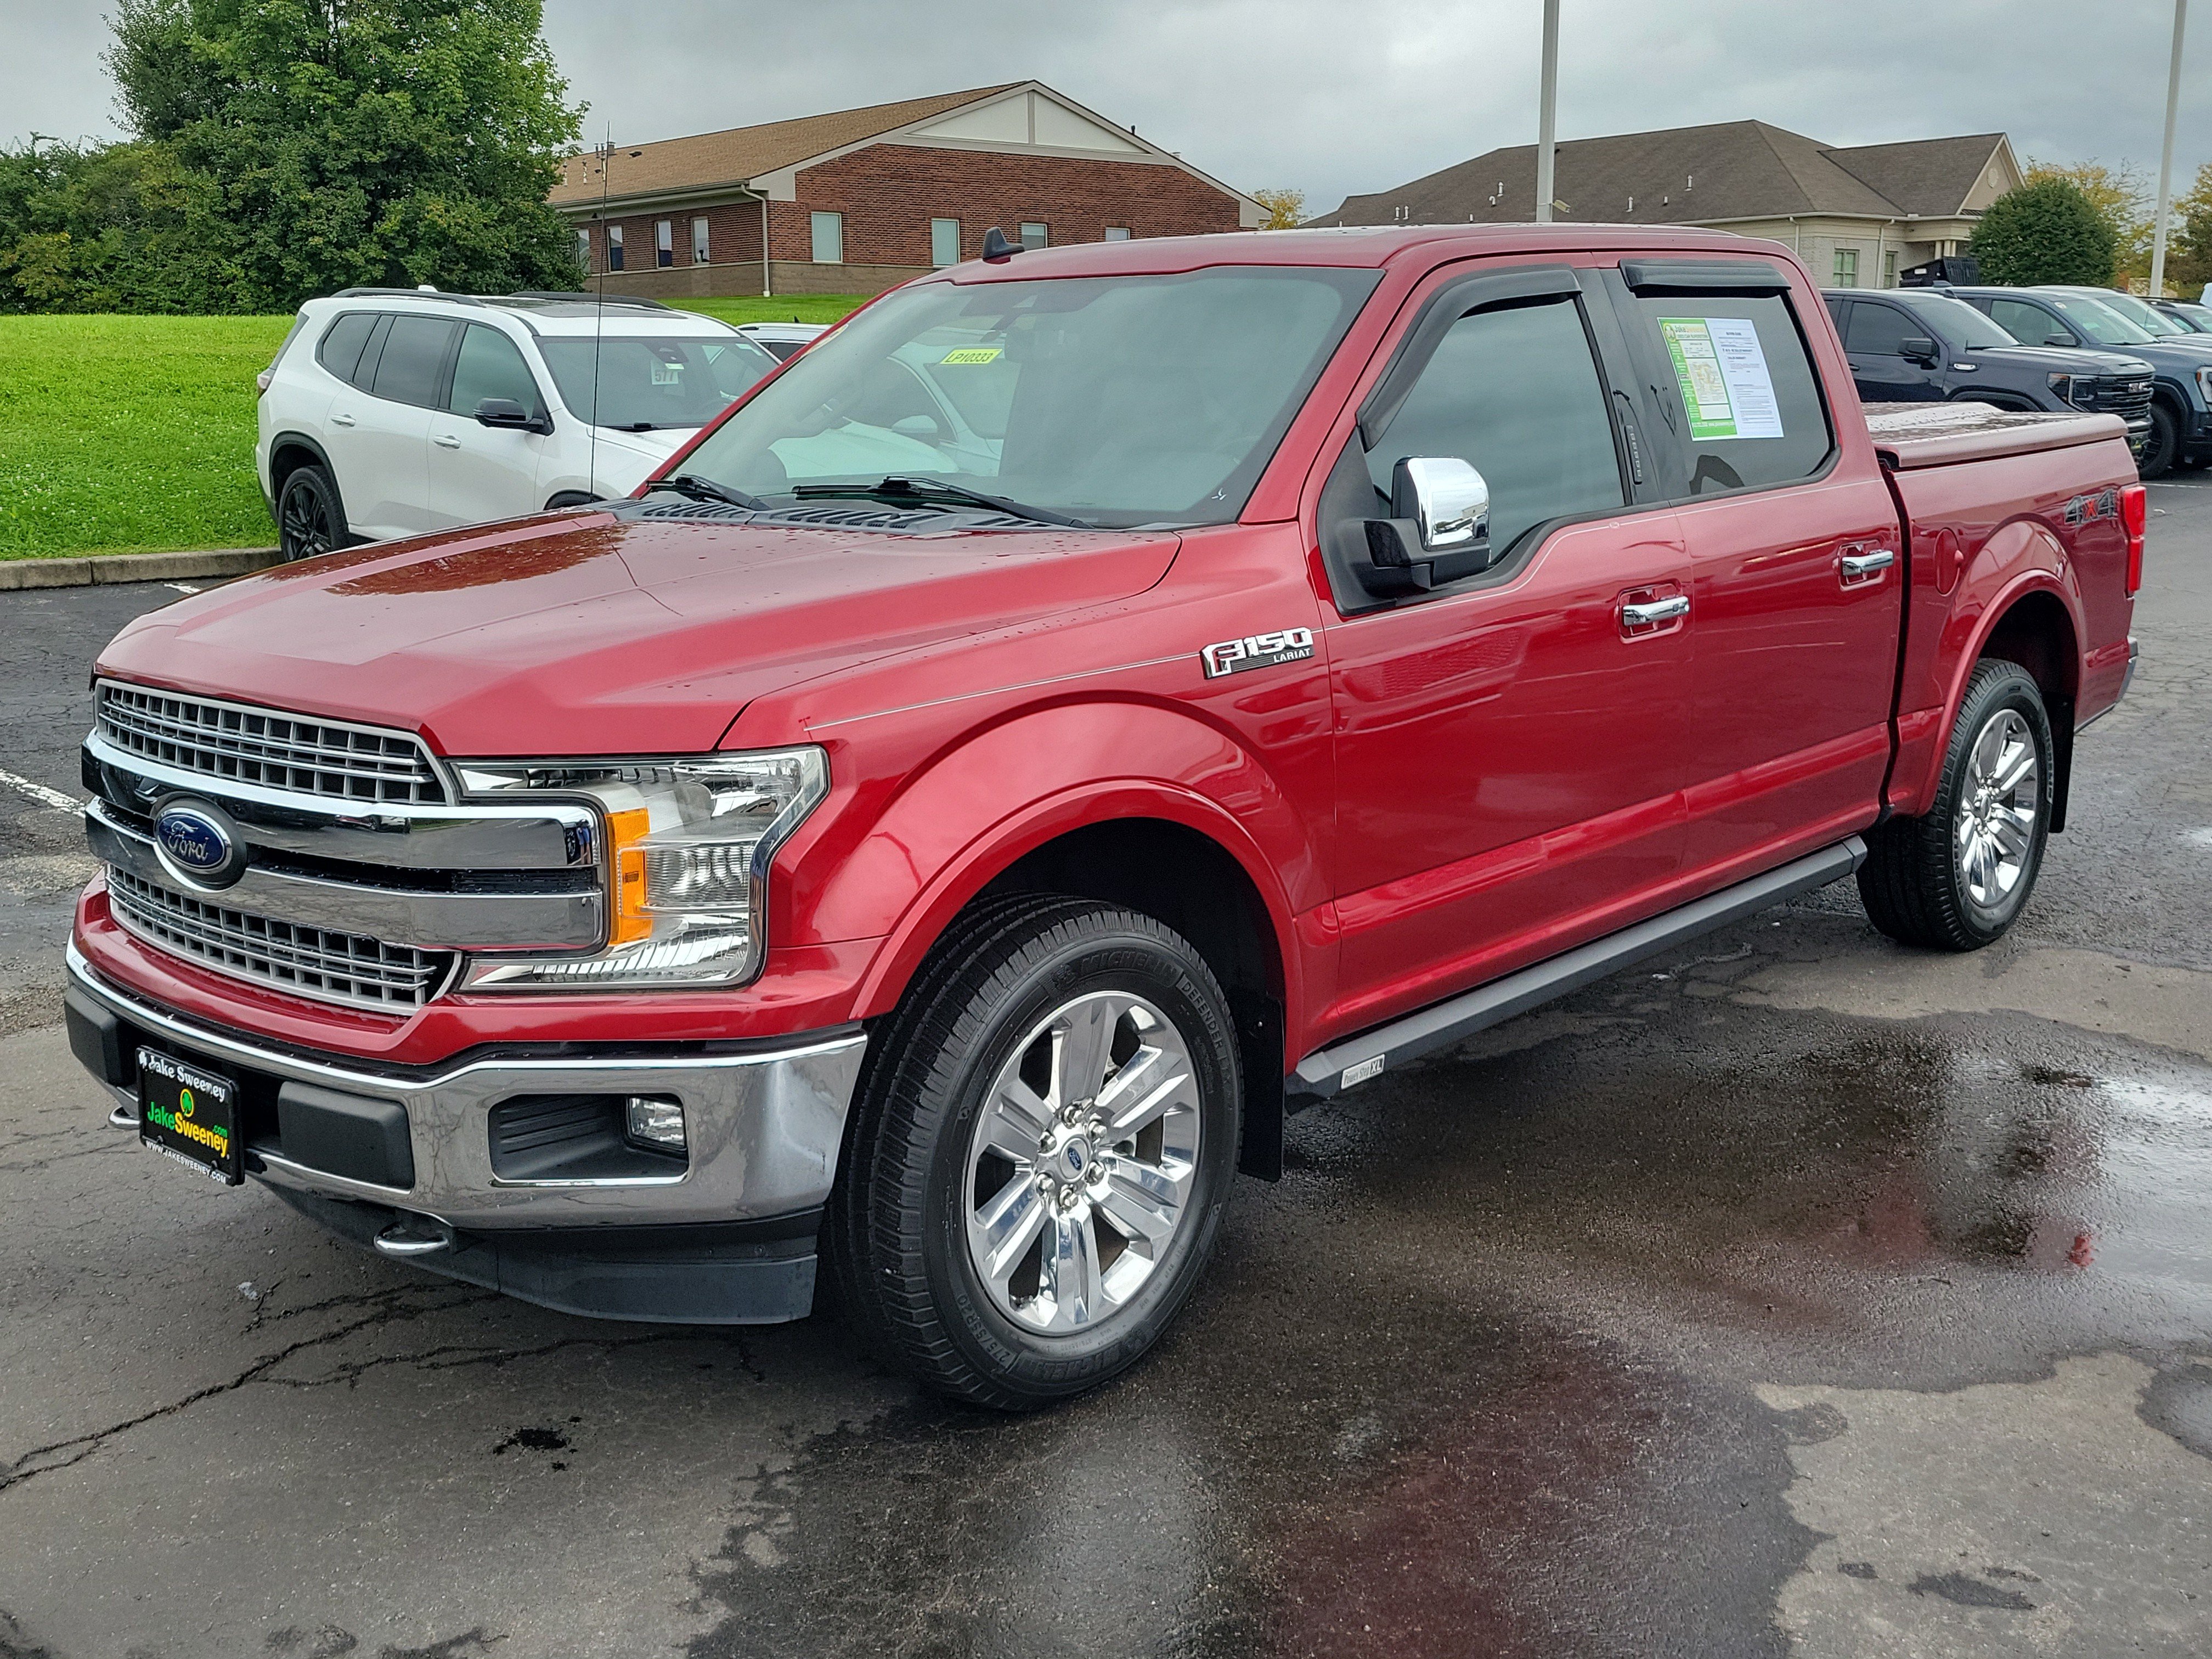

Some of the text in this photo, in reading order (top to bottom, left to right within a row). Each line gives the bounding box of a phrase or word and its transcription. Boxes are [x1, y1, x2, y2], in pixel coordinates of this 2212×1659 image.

[944, 353, 994, 363] LP10333
[1273, 648, 1311, 663] LARIAT
[164, 820, 209, 862] Ford
[1081, 951, 1177, 978] MICHELIN
[1181, 981, 1223, 1049] DEFENDER
[148, 1054, 225, 1103] Jake Sweeney
[1370, 1059, 1381, 1074] XL
[146, 1140, 226, 1184] WWW.JAKESWEENEY.COM
[1069, 1152, 1080, 1168] Ford
[957, 1293, 1012, 1363] 275/55R20
